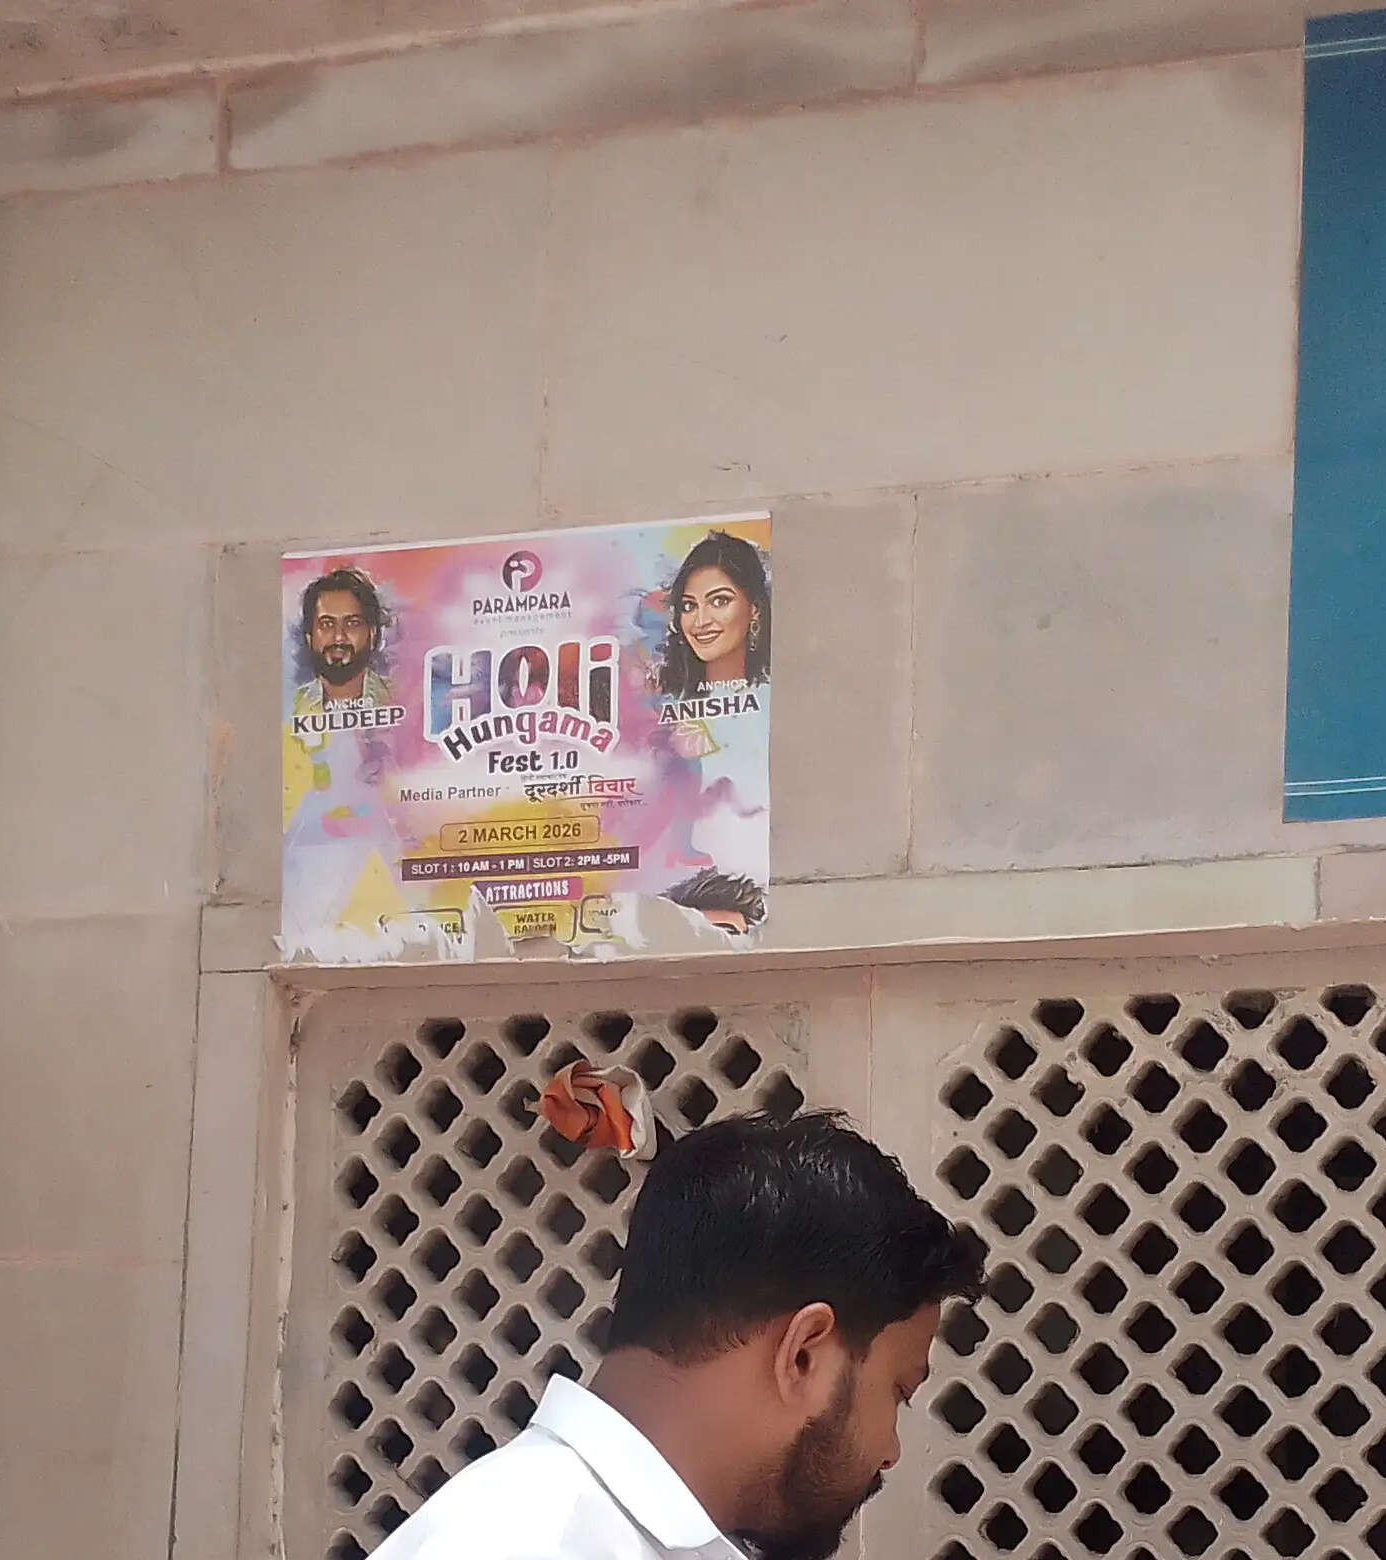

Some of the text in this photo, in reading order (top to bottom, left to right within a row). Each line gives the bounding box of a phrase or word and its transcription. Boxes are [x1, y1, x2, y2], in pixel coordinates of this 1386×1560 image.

[473, 591, 571, 615] PARAMPARA
[697, 679, 749, 693] ANCHOR
[660, 694, 760, 723] ANISHA
[293, 707, 405, 734] KULDEEP
[442, 710, 614, 761] Hungama
[488, 750, 578, 774] Fest 1.0
[400, 786, 501, 802] Media Partner
[524, 774, 644, 802] दूरदर्शी विचार
[458, 823, 582, 844] 2 MARCH 2026
[411, 863, 440, 875] SLOT
[458, 861, 470, 873] 10
[471, 860, 490, 872] AM
[507, 858, 525, 870] PM
[532, 857, 562, 869] SLOT
[577, 854, 601, 866] 2PM
[485, 880, 570, 902] ATTRACTIONS
[516, 912, 555, 924] WATER
